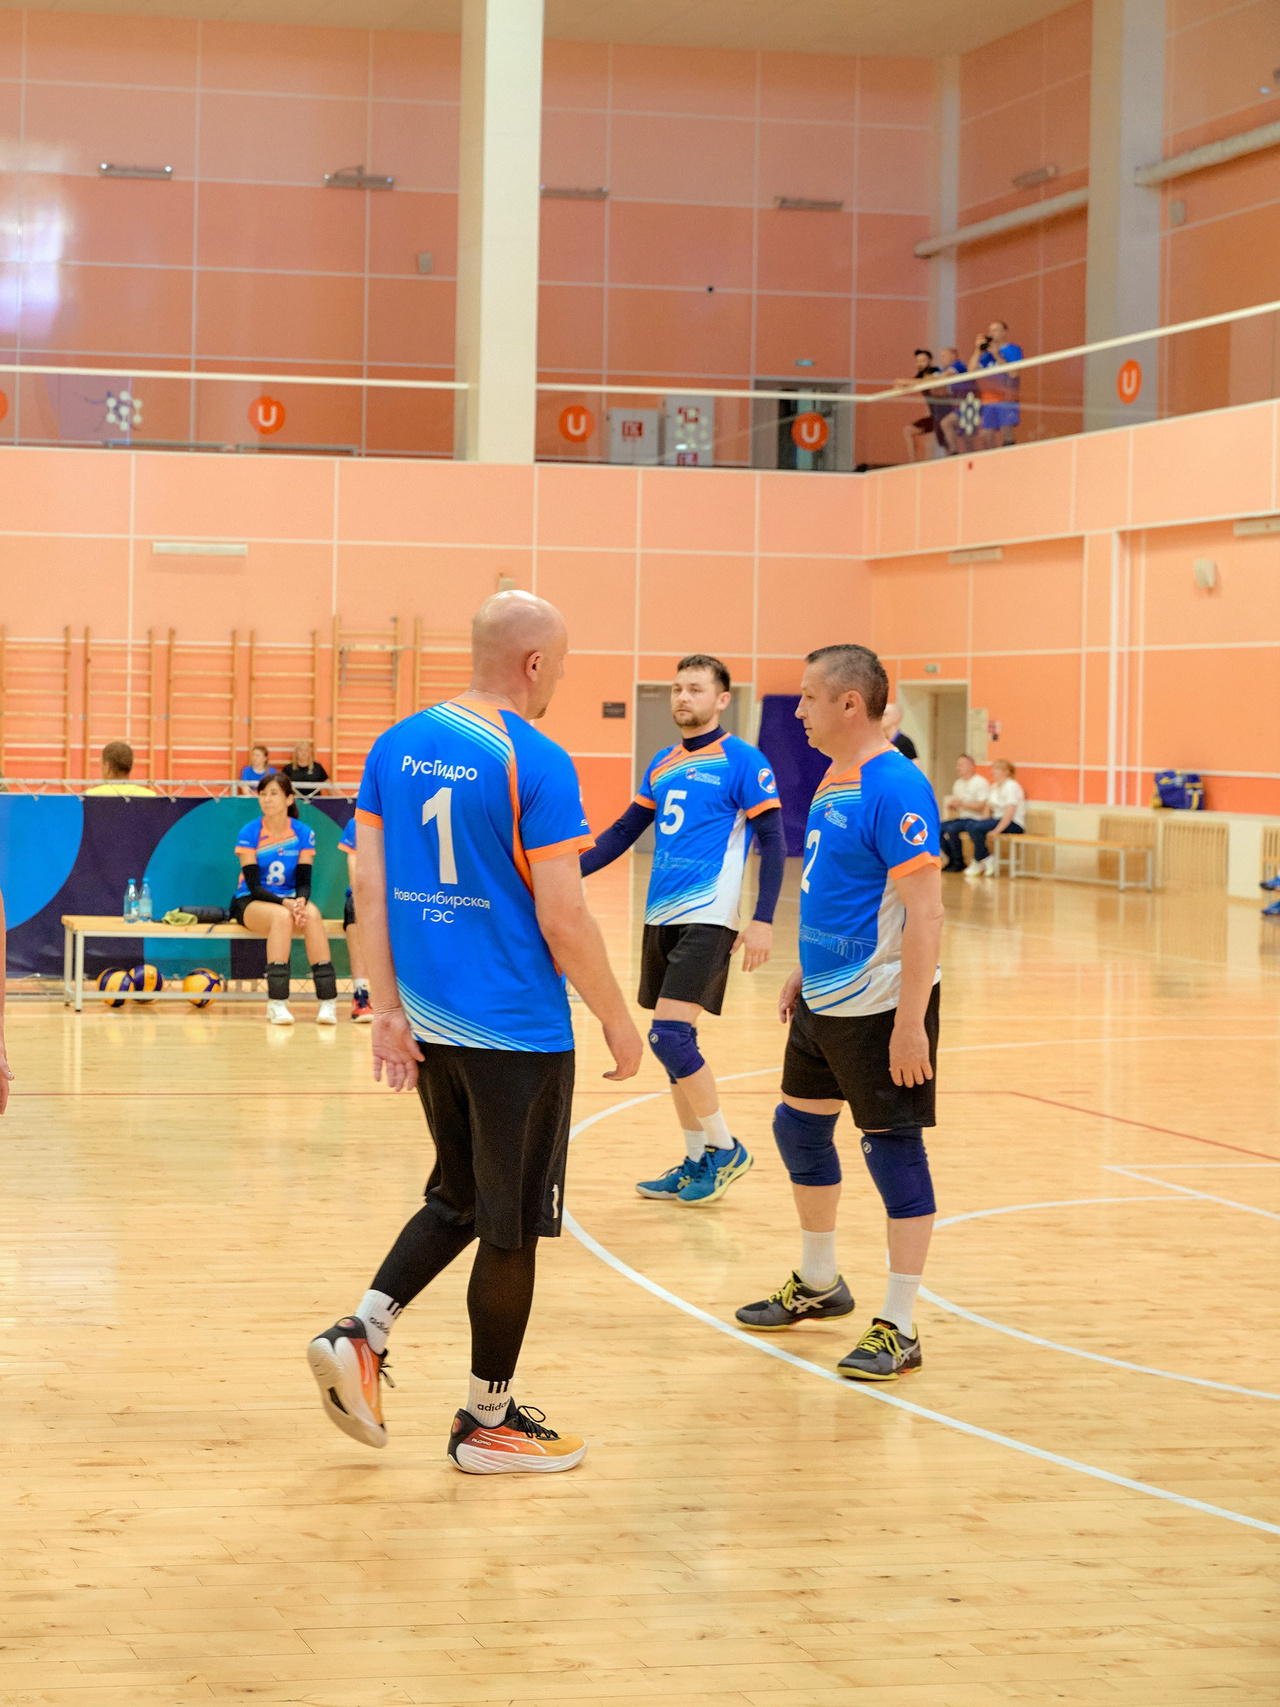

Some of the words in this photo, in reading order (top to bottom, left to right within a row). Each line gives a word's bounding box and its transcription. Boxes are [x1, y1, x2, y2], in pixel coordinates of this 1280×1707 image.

[1122, 369, 1137, 395] U
[258, 405, 277, 427] U
[567, 413, 587, 436] U
[801, 422, 821, 443] U
[401, 755, 478, 782] РусГидро
[659, 789, 688, 835] 5
[422, 786, 459, 885] 1
[266, 860, 286, 886] 8
[800, 829, 822, 894] 2
[393, 887, 491, 910] Новосибирская
[422, 908, 455, 924] ГЭС
[551, 1183, 560, 1219] 1
